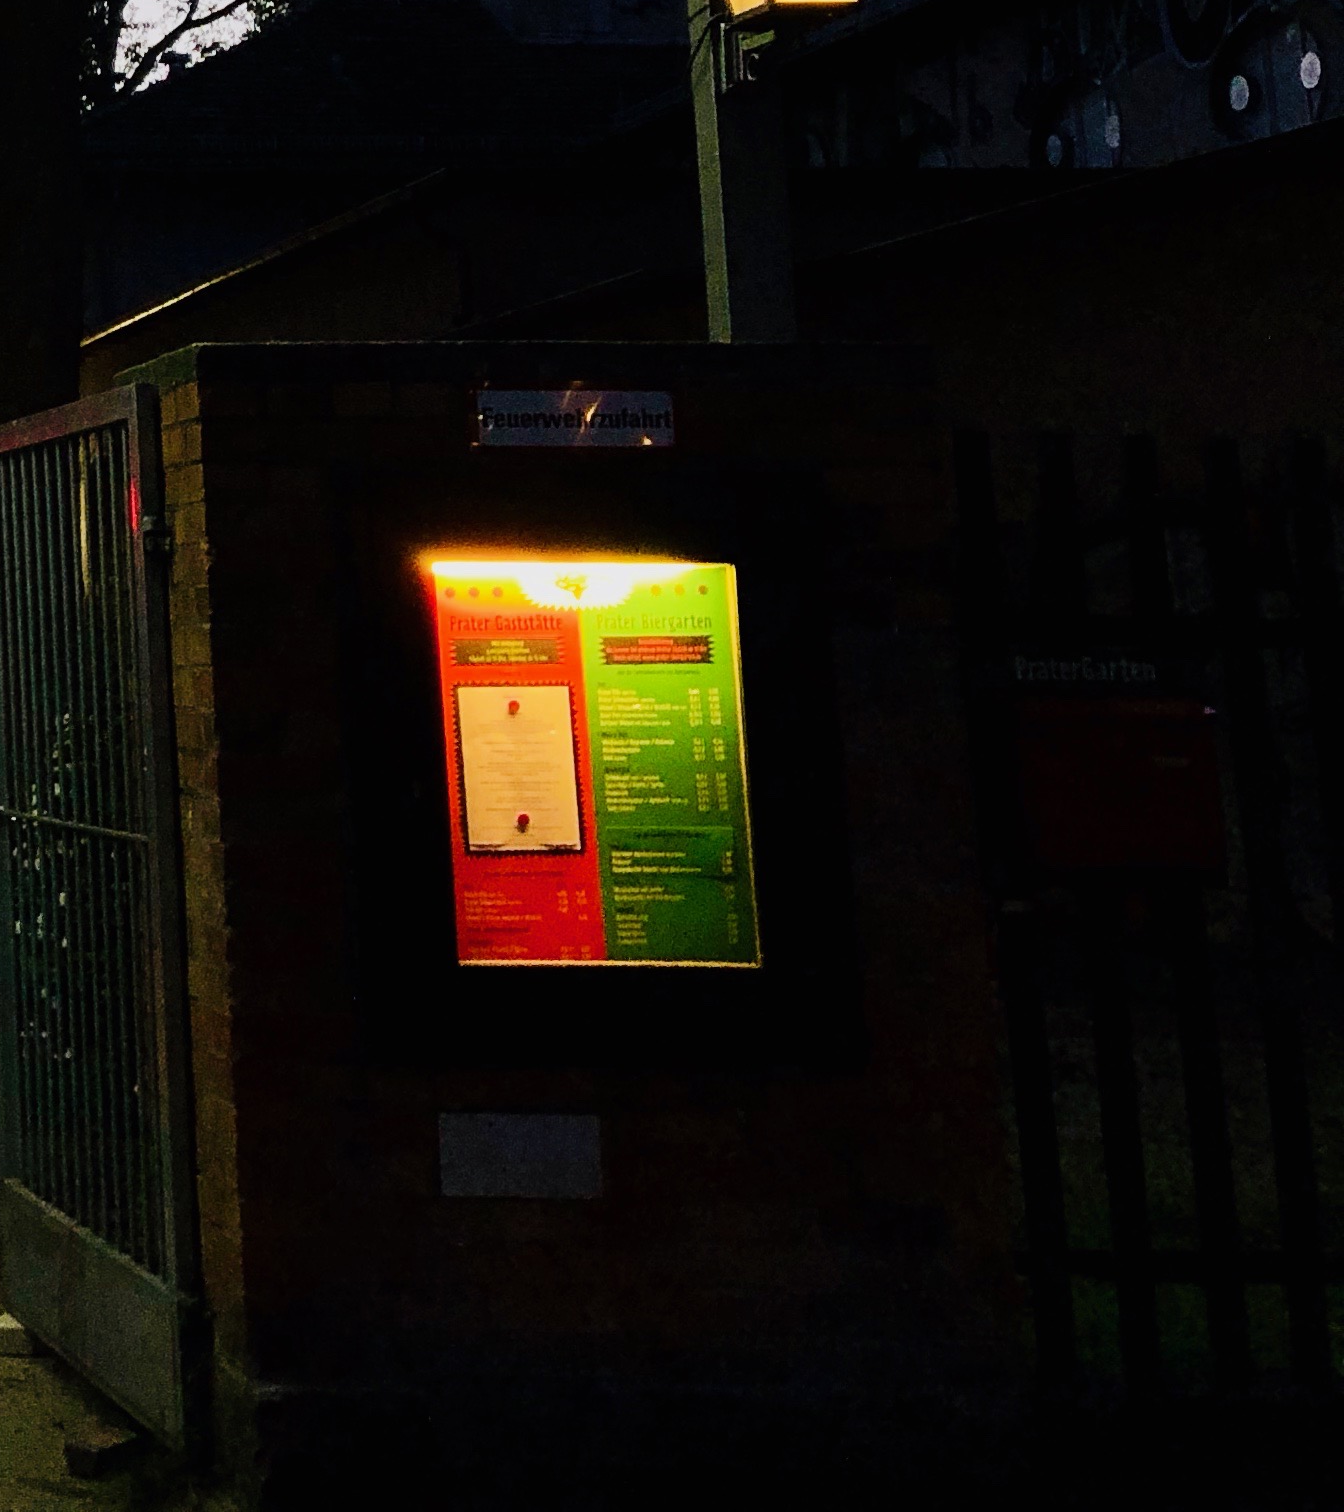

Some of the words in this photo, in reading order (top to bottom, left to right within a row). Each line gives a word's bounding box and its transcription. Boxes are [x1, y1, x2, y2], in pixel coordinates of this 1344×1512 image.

[449, 615, 490, 632] Prater
[495, 613, 564, 631] Gaststätte
[641, 613, 713, 633] Biergarten
